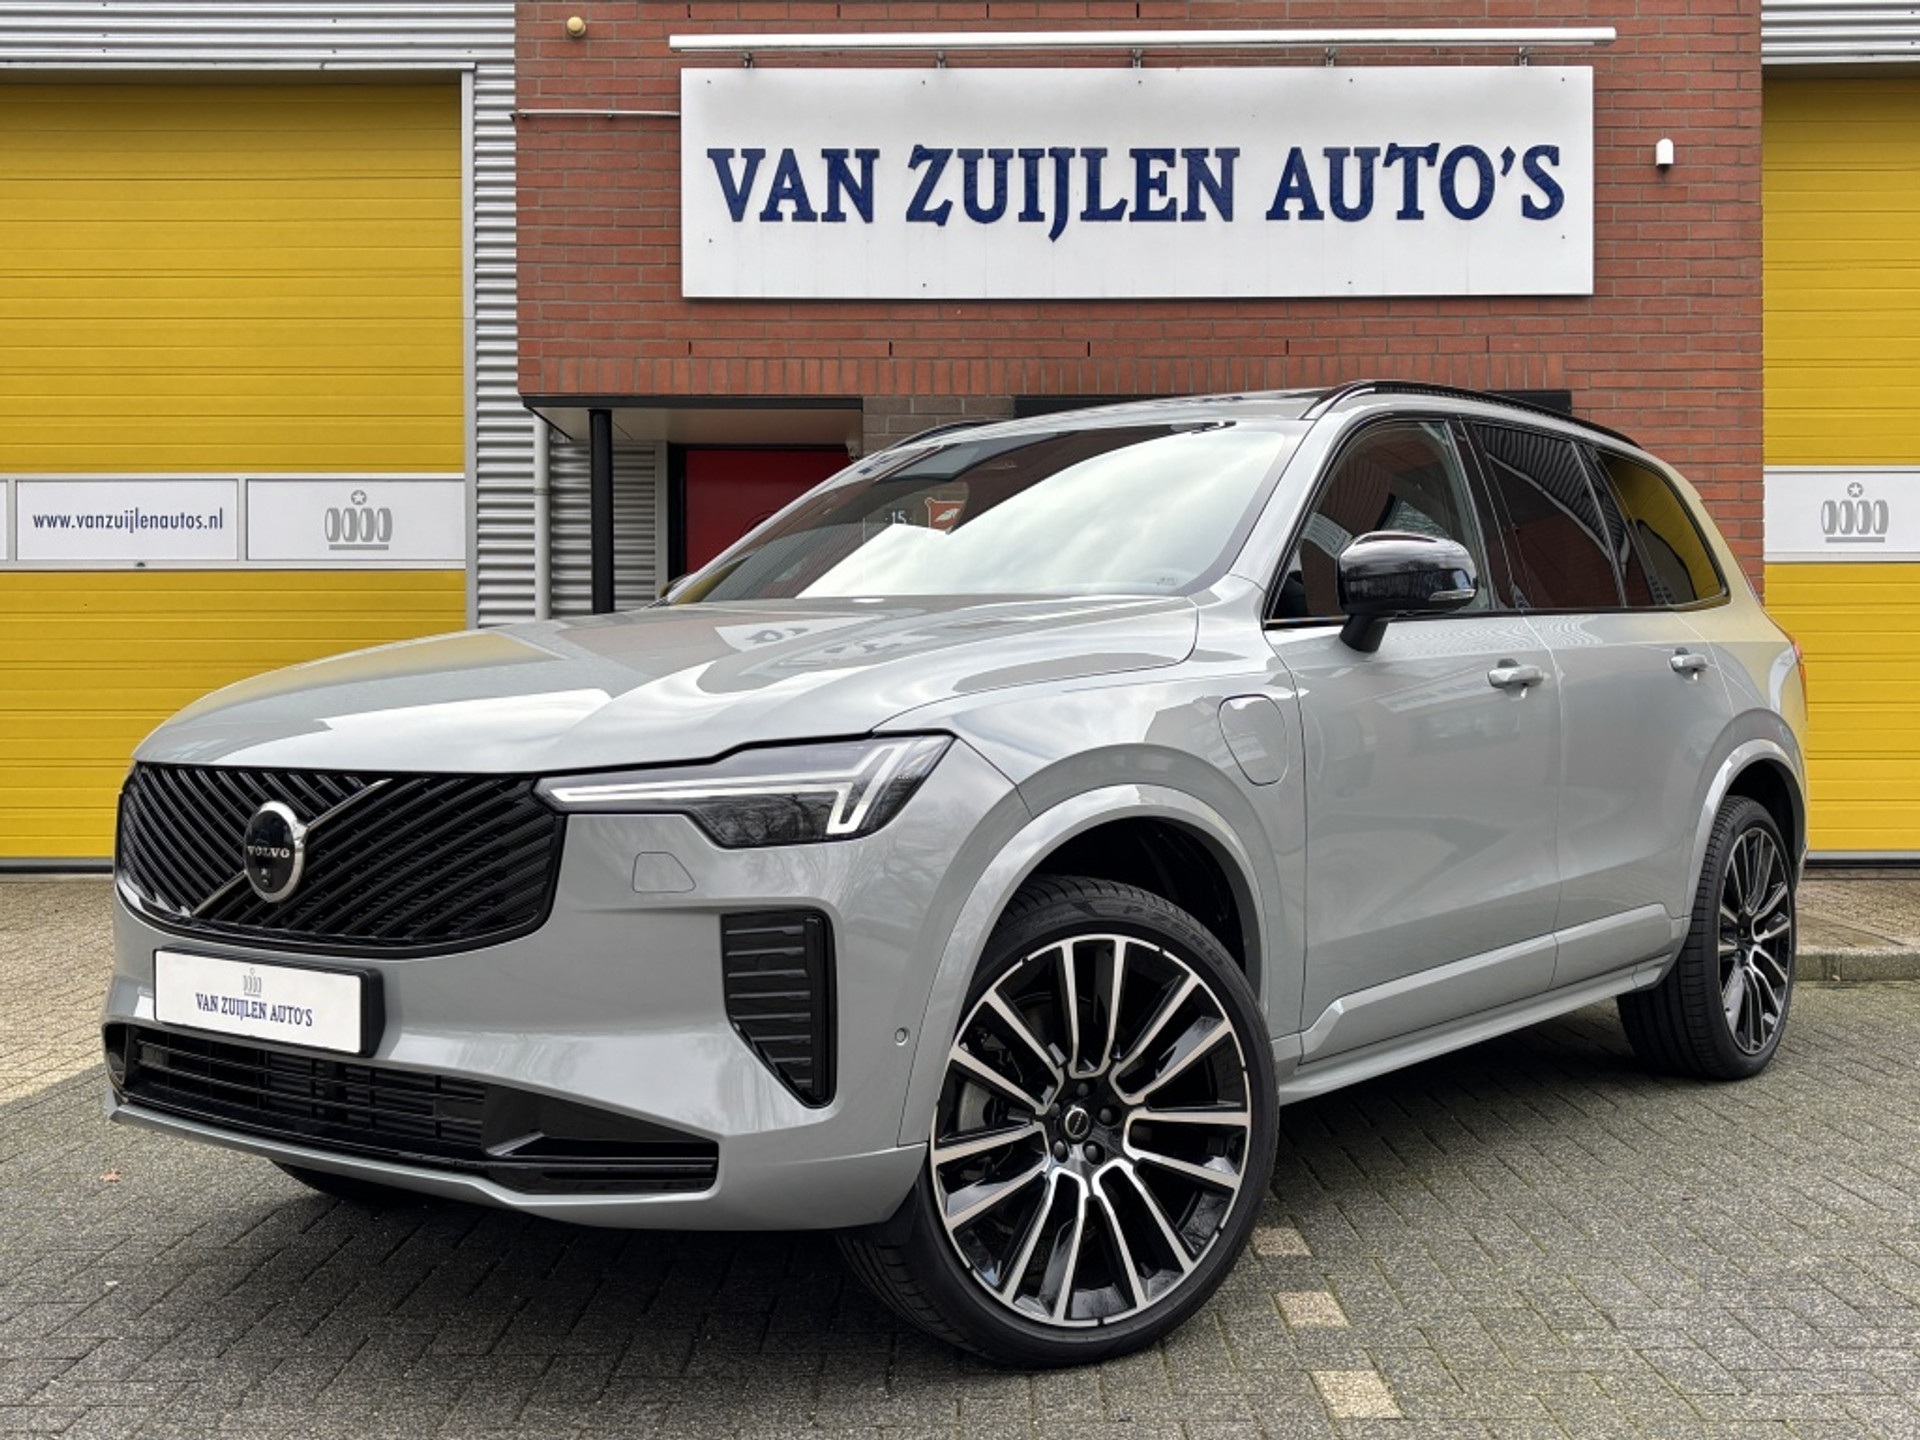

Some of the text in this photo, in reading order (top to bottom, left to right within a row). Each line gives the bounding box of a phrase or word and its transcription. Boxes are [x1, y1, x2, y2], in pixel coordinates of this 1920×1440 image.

[706, 142, 1565, 242] VAN ZUIJLEN AUTO'S
[33, 506, 223, 534] www.vanzuijlenautos.nl
[247, 845, 290, 858] VOLVO
[195, 992, 313, 1027] VAN ZUIJLEN AUTO'S
